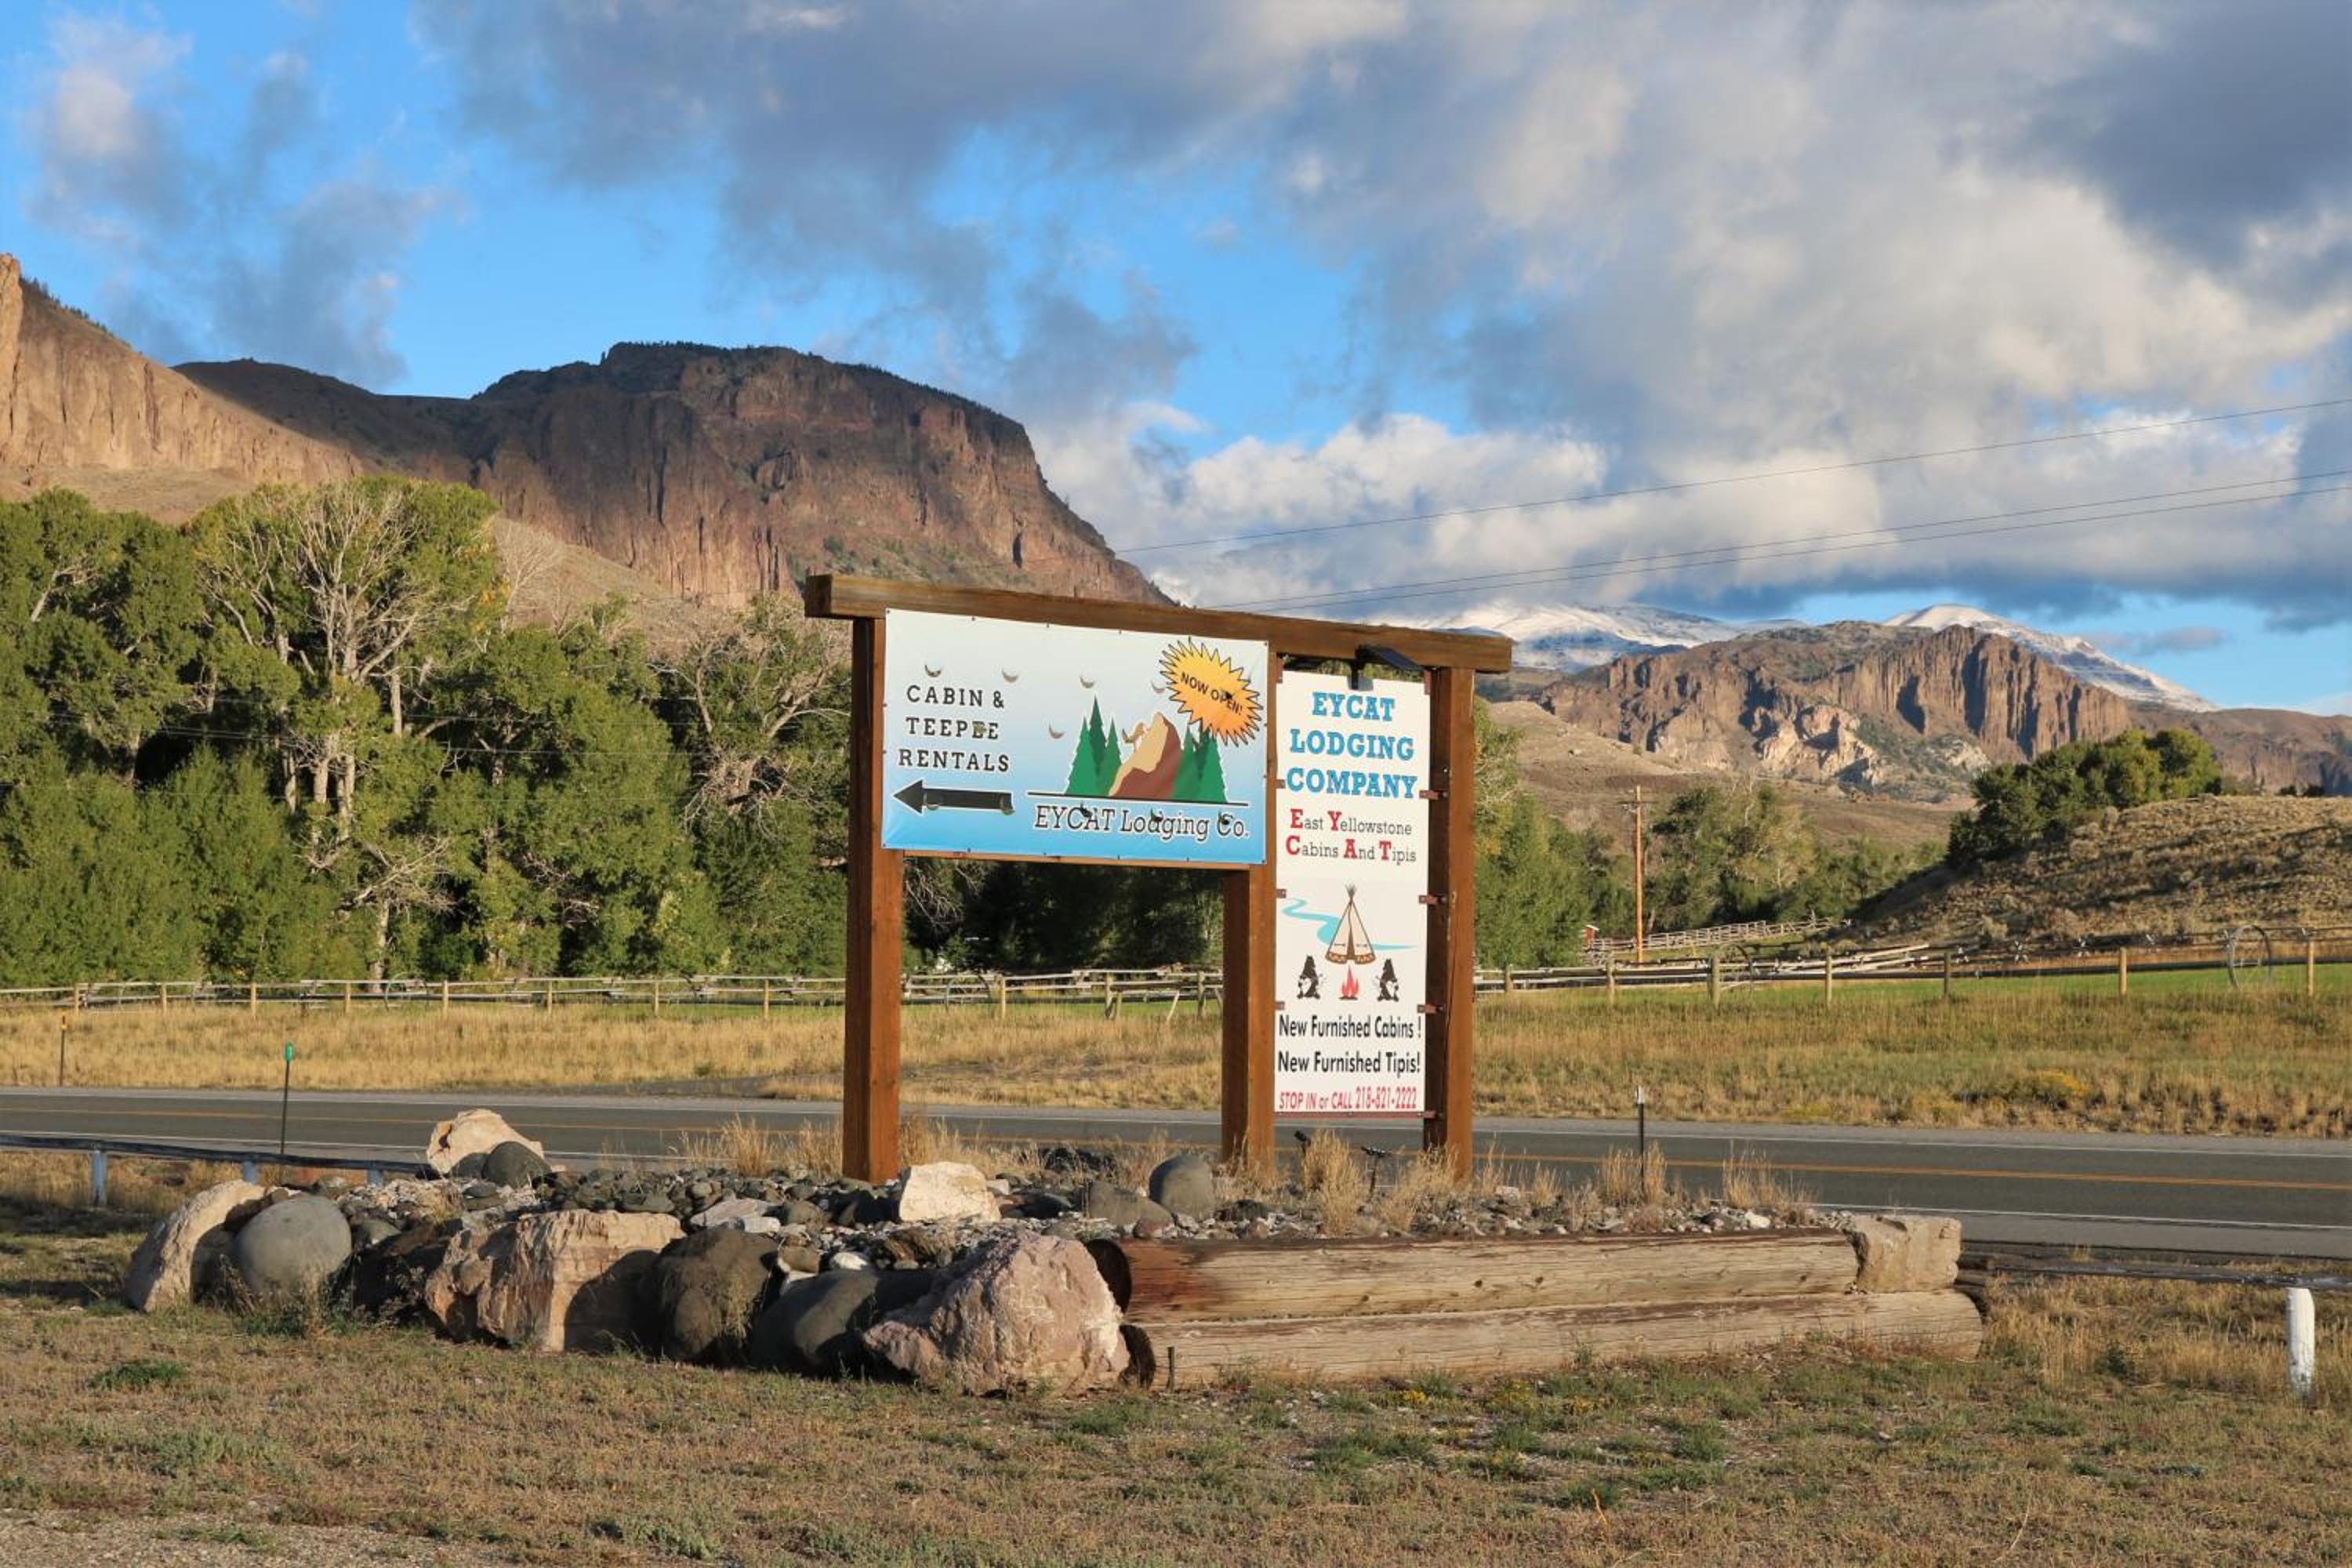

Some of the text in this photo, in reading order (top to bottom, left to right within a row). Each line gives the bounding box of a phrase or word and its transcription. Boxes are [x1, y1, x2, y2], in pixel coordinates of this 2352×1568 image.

[906, 684, 1004, 708] CABIN &
[1180, 672, 1209, 694] NOW
[1312, 691, 1396, 721] EYCAT
[906, 717, 999, 739] TEEPEE
[1290, 728, 1414, 760] LODGING
[898, 749, 1009, 772] RENTALS
[1287, 768, 1417, 799] COMPANY
[1034, 805, 1250, 841] EYCAT Lodging Co.
[1290, 808, 1412, 836] East Yellowstone
[1286, 836, 1417, 866] Cabins And Tipis
[1279, 1014, 1308, 1037] New
[1312, 1014, 1370, 1038] Furnished
[1278, 1051, 1421, 1078] New Furnished Tipis!
[1279, 1091, 1304, 1109] STOP
[1306, 1092, 1318, 1109] IN
[1319, 1097, 1329, 1109] or
[1330, 1091, 1352, 1109] CALL
